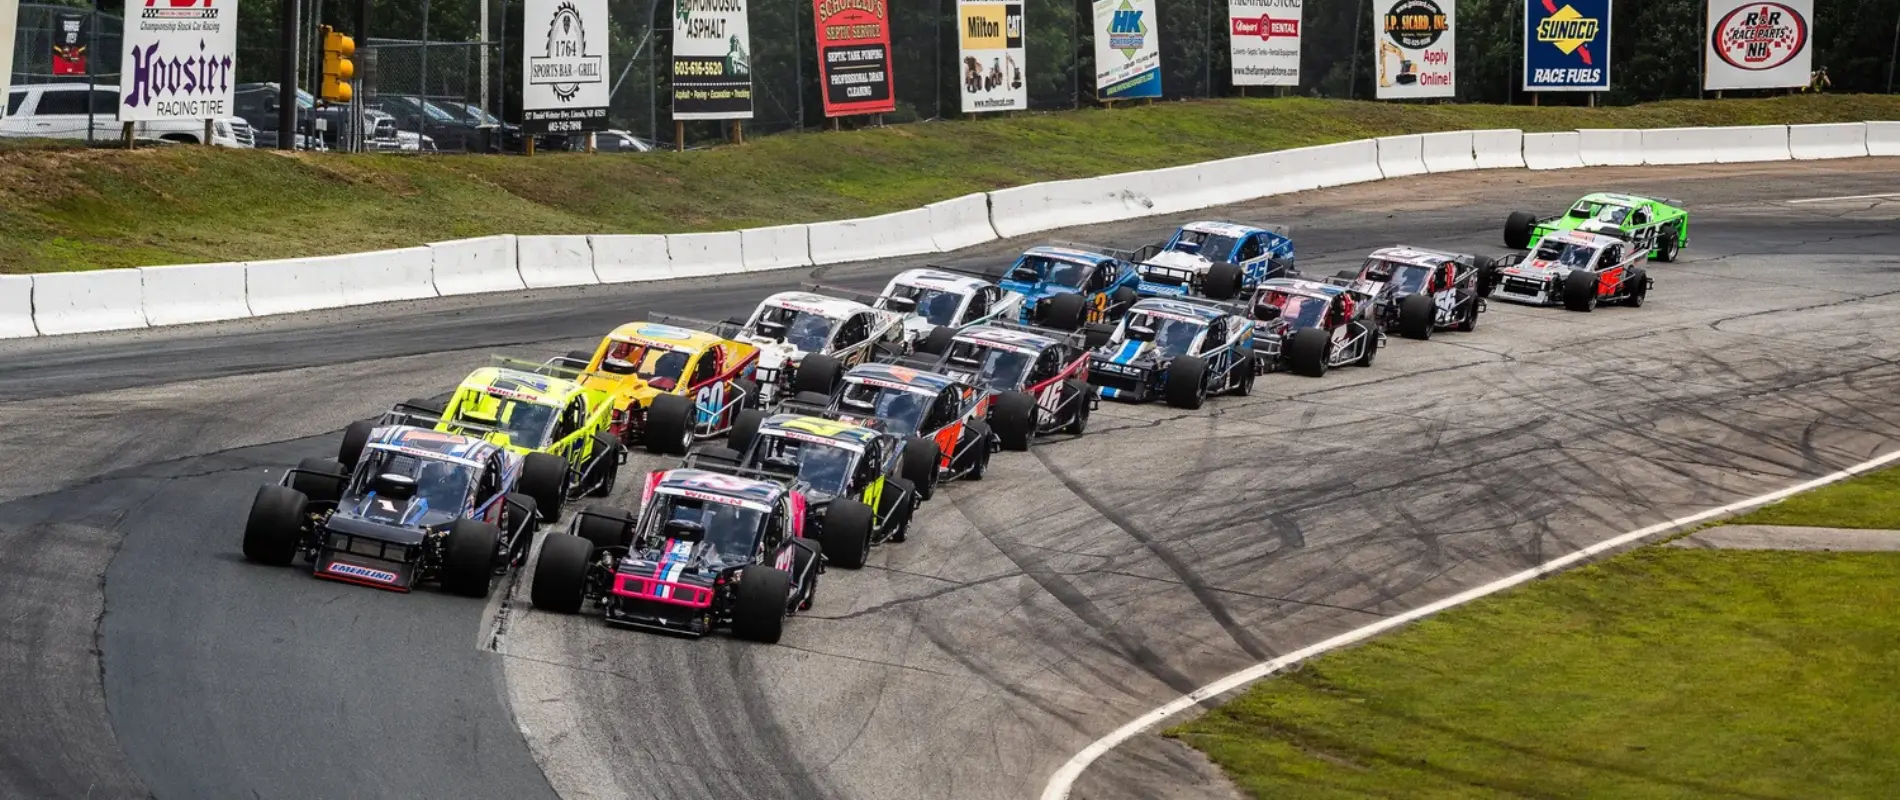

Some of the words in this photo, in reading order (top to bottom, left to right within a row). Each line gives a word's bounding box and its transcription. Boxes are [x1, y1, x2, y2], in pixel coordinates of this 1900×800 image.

[140, 21, 176, 32] Championship
[177, 21, 192, 31] Stock
[192, 21, 202, 31] Car
[203, 21, 220, 34] Racing
[686, 18, 727, 39] ASPHALT
[967, 15, 1000, 39] Milton
[1006, 14, 1022, 38] CAT
[1111, 10, 1145, 33] HK
[1271, 22, 1296, 34] RENTAL
[1384, 13, 1399, 34] J.P.
[1401, 14, 1432, 31] SICARD,
[1433, 13, 1449, 31] INC.
[1538, 19, 1597, 40] SUNOCO
[826, 25, 851, 40] SEPTIC
[852, 23, 881, 39] SERVICE
[1732, 28, 1755, 40] RACE
[1756, 27, 1786, 40] PARTS
[555, 40, 577, 57] 1764
[827, 51, 847, 62] SEPTIC
[847, 50, 861, 62] TANK
[861, 48, 883, 61] PUMPING
[1423, 48, 1449, 65] Apply
[1747, 42, 1768, 57] NH
[124, 38, 232, 108] Hoosier
[533, 63, 558, 77] SPORTS
[559, 63, 572, 77] BAR
[579, 62, 599, 77] GRILL
[674, 60, 723, 76] 603-616-5620
[1233, 65, 1298, 79] www.thefarmyardstore.com
[1534, 68, 1566, 83] RACE
[1566, 67, 1601, 83] FUELS
[831, 73, 868, 85] PROFESSIONAL
[868, 71, 884, 82] DRAIN
[1420, 71, 1451, 86] Online!
[675, 89, 691, 100] Asphalt
[847, 85, 872, 98] CLEANING
[157, 101, 198, 116] RACING
[200, 100, 224, 115] TIRE
[782, 301, 825, 314] WHELEN
[628, 335, 675, 350] WHELEN
[486, 385, 539, 402] WHELEN
[695, 380, 725, 430] 60
[784, 430, 837, 446] WHELEN
[683, 489, 744, 506] WHELEN
[378, 499, 398, 513] 1
[331, 564, 395, 582] EMERLING
